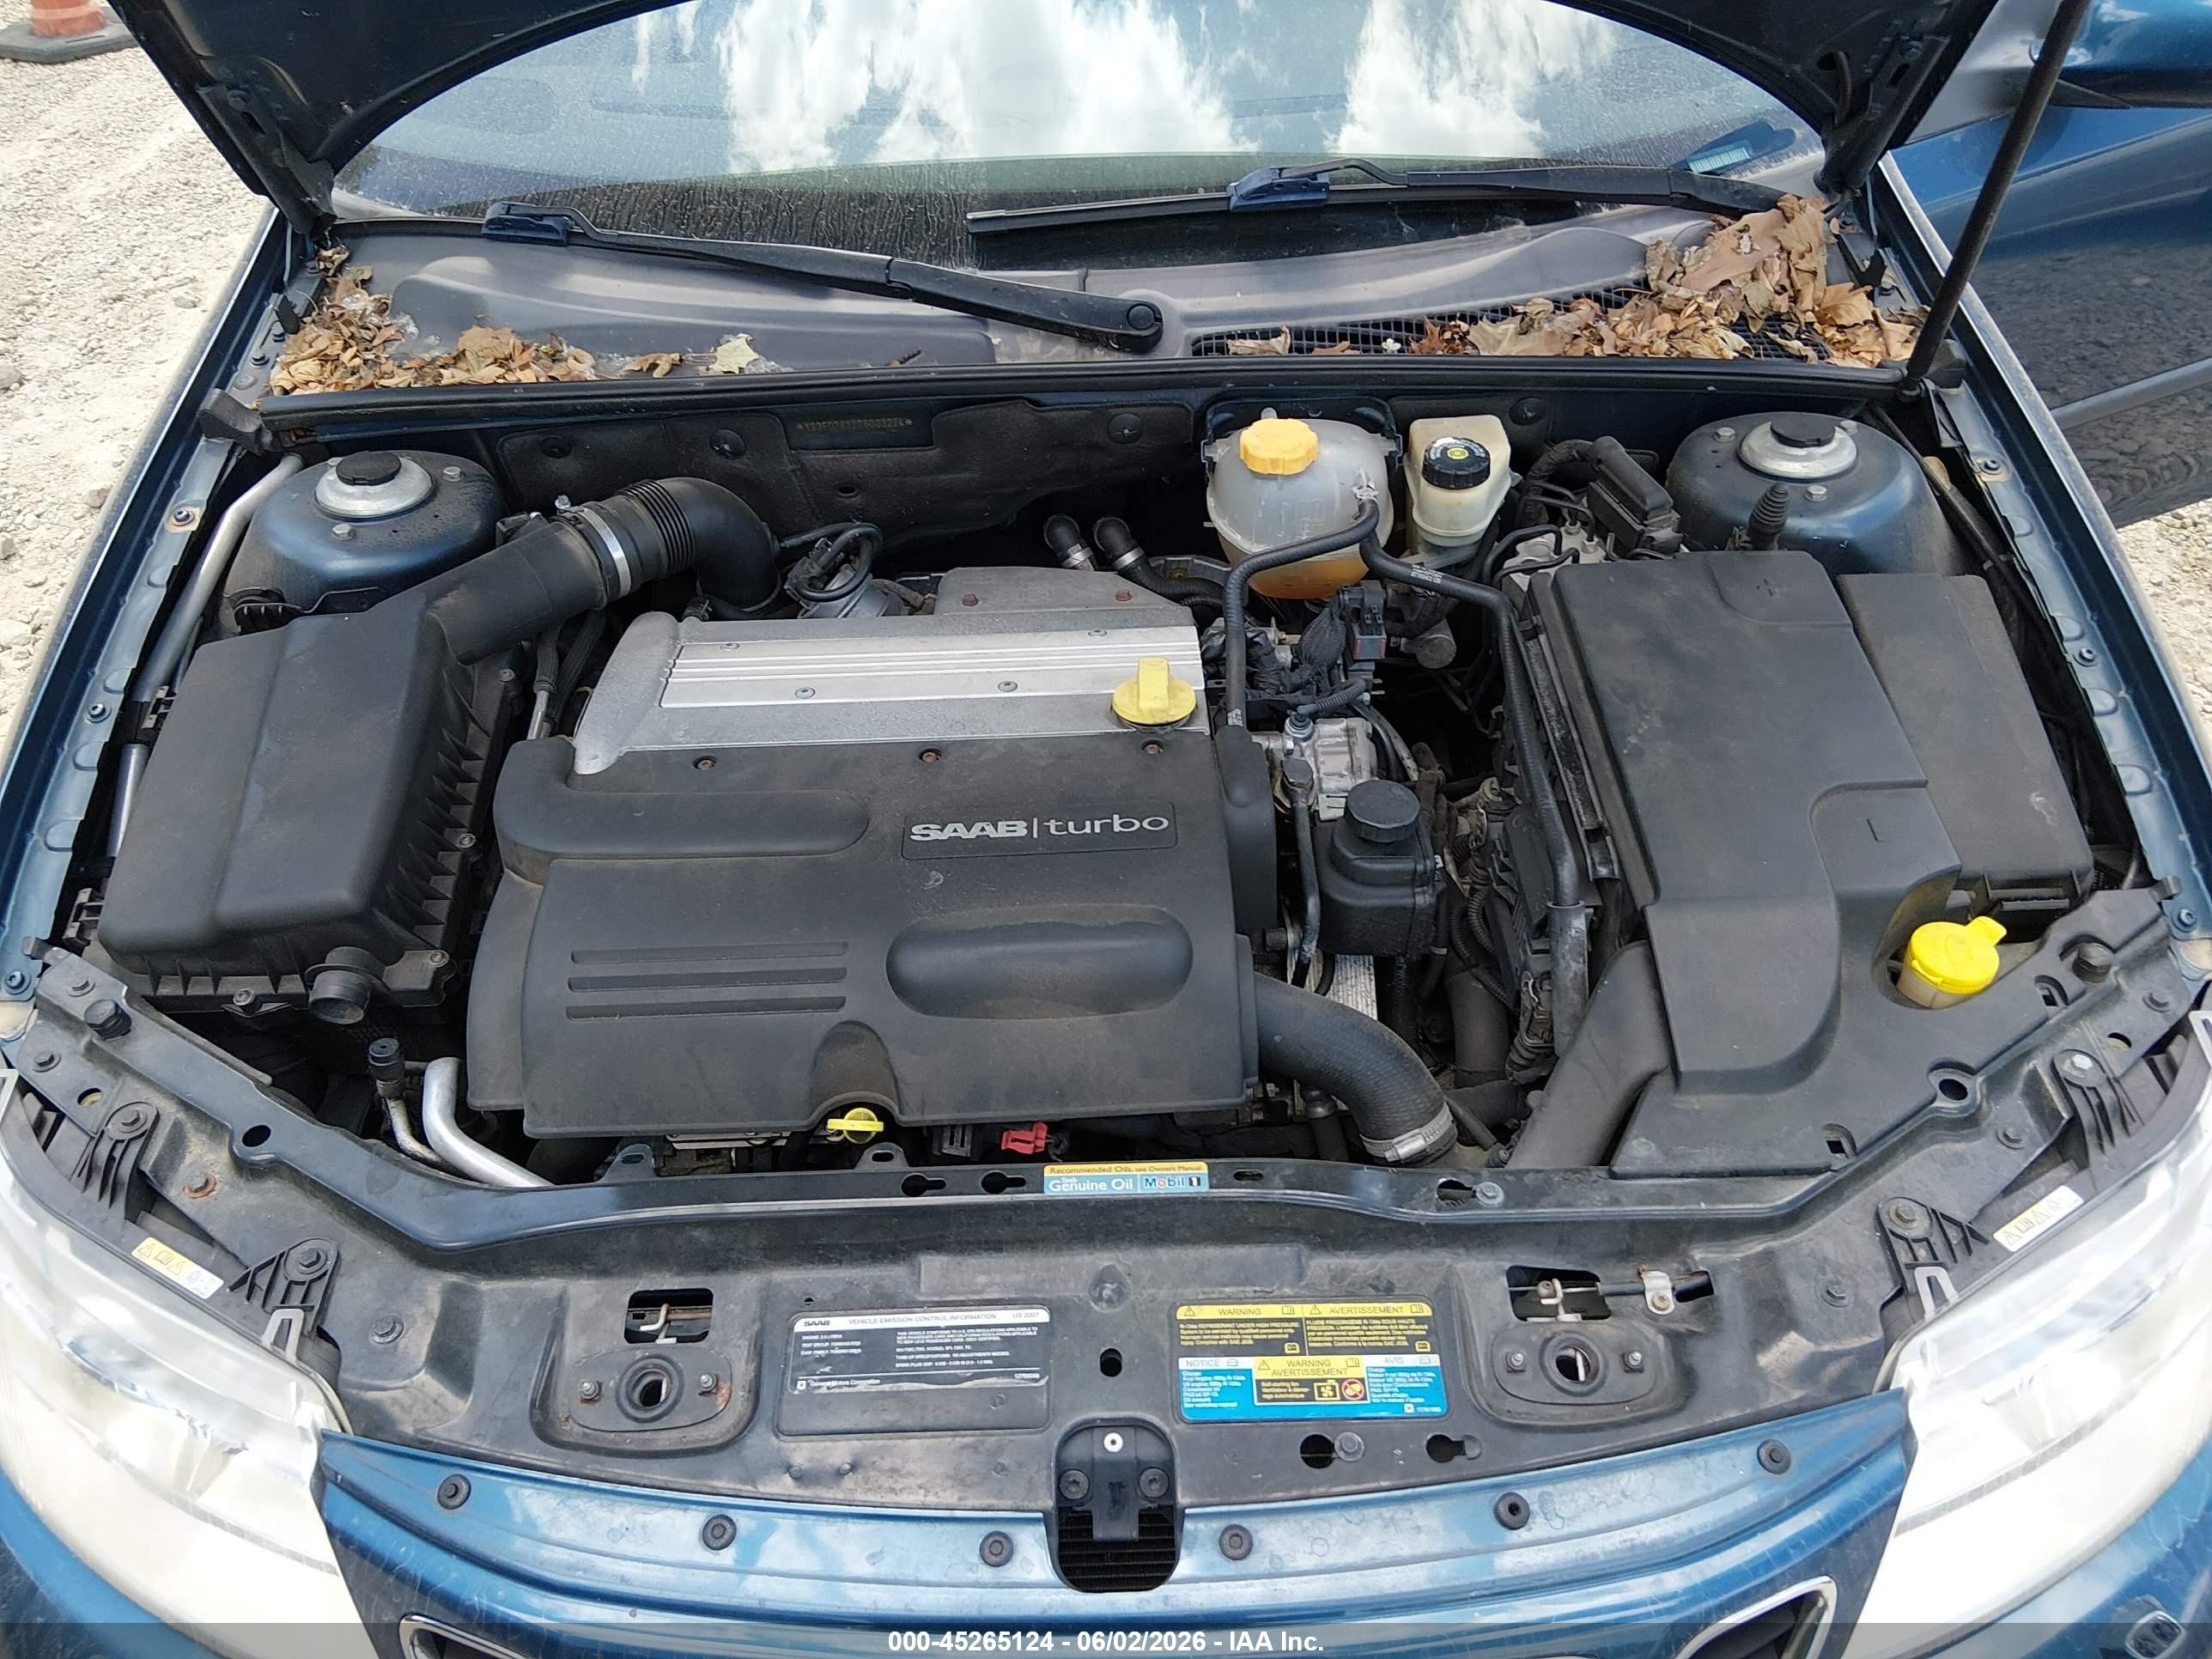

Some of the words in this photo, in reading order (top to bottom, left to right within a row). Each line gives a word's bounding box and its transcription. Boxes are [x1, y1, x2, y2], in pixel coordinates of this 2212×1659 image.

[910, 820, 1028, 842] SAAB
[1043, 814, 1169, 836] turbo
[1049, 1166, 1111, 1175] Recommended
[1048, 1179, 1108, 1192] Genuine
[1111, 1178, 1133, 1190] Oil
[1145, 1176, 1185, 1187] Mobil
[1329, 1306, 1404, 1315] AVERTISSEMENT
[1286, 1358, 1331, 1368] WARNING
[1271, 1367, 1348, 1376] AVERTISSEMENT
